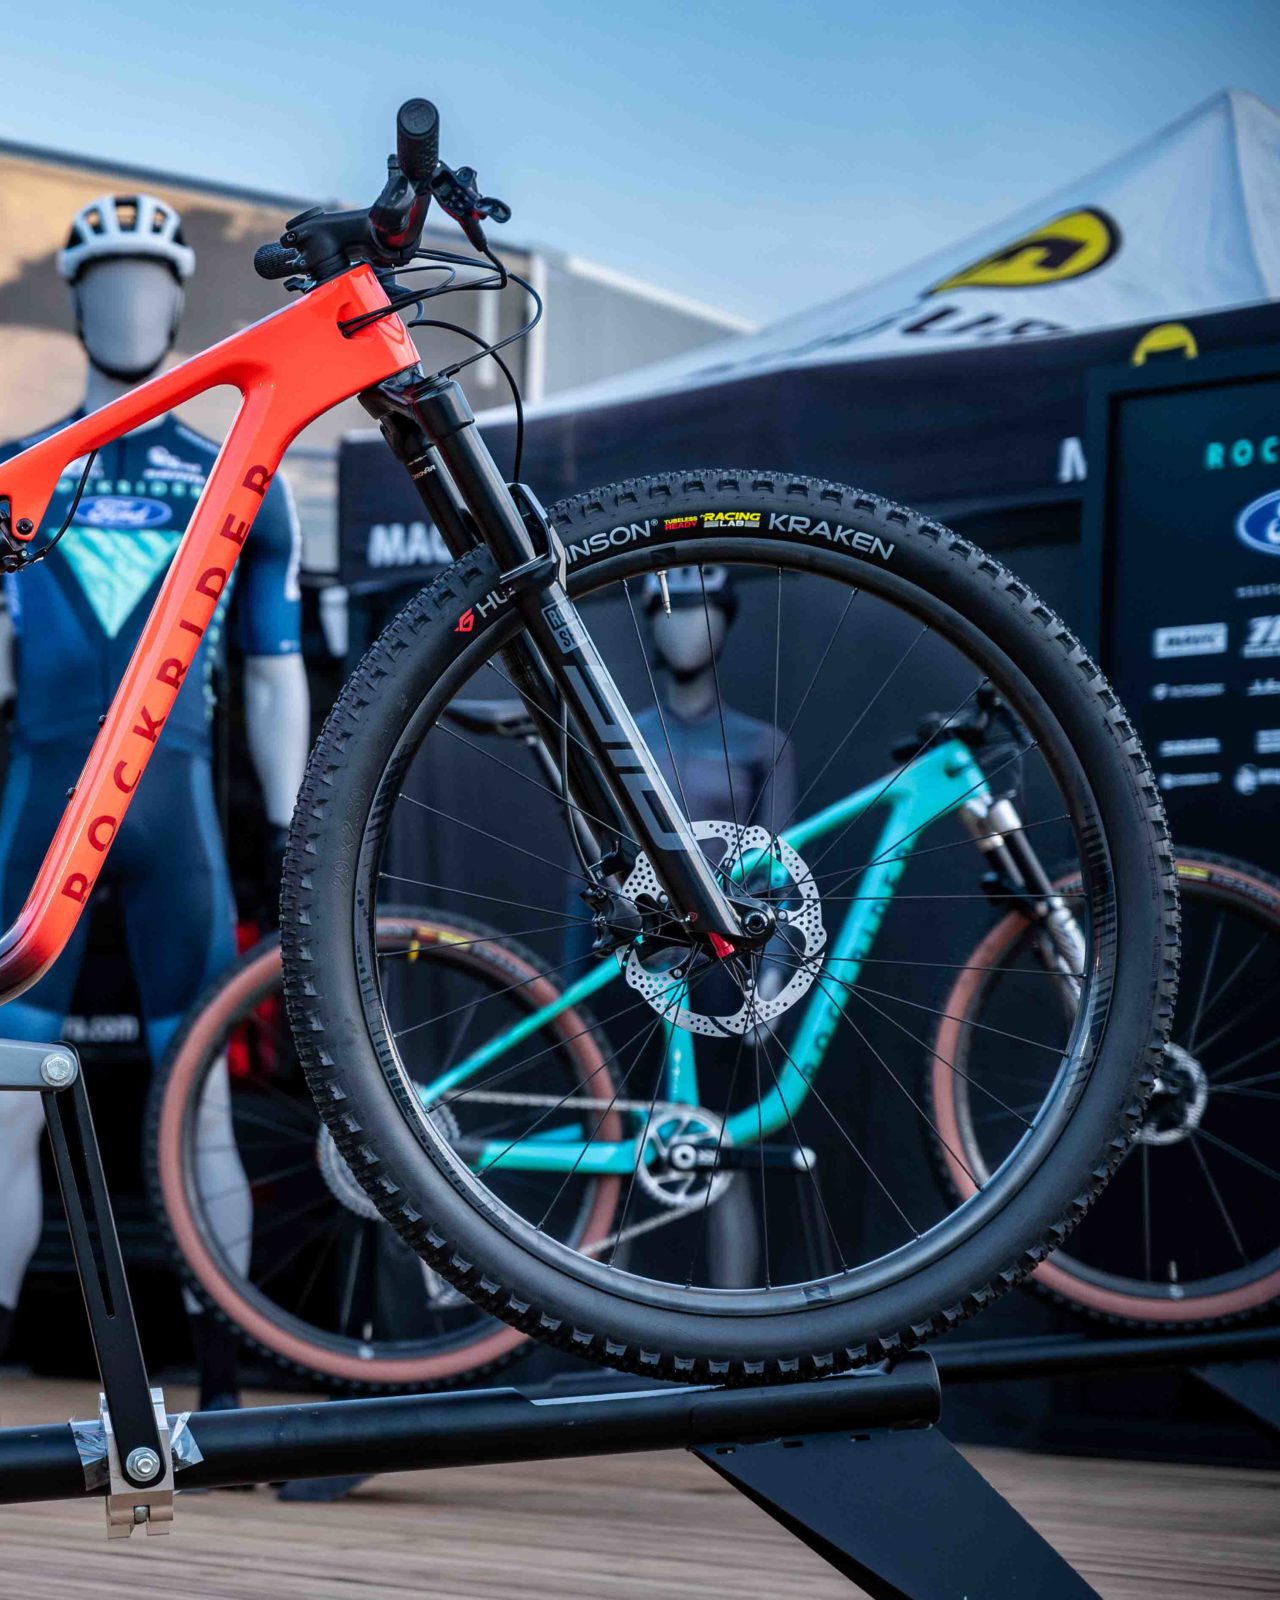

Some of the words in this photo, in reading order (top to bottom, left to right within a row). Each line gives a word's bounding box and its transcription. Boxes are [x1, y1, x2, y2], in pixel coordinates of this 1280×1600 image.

[664, 521, 698, 531] READY
[703, 512, 762, 521] RACING
[769, 513, 895, 561] KRAKEN
[62, 464, 274, 904] ROCKRIDER
